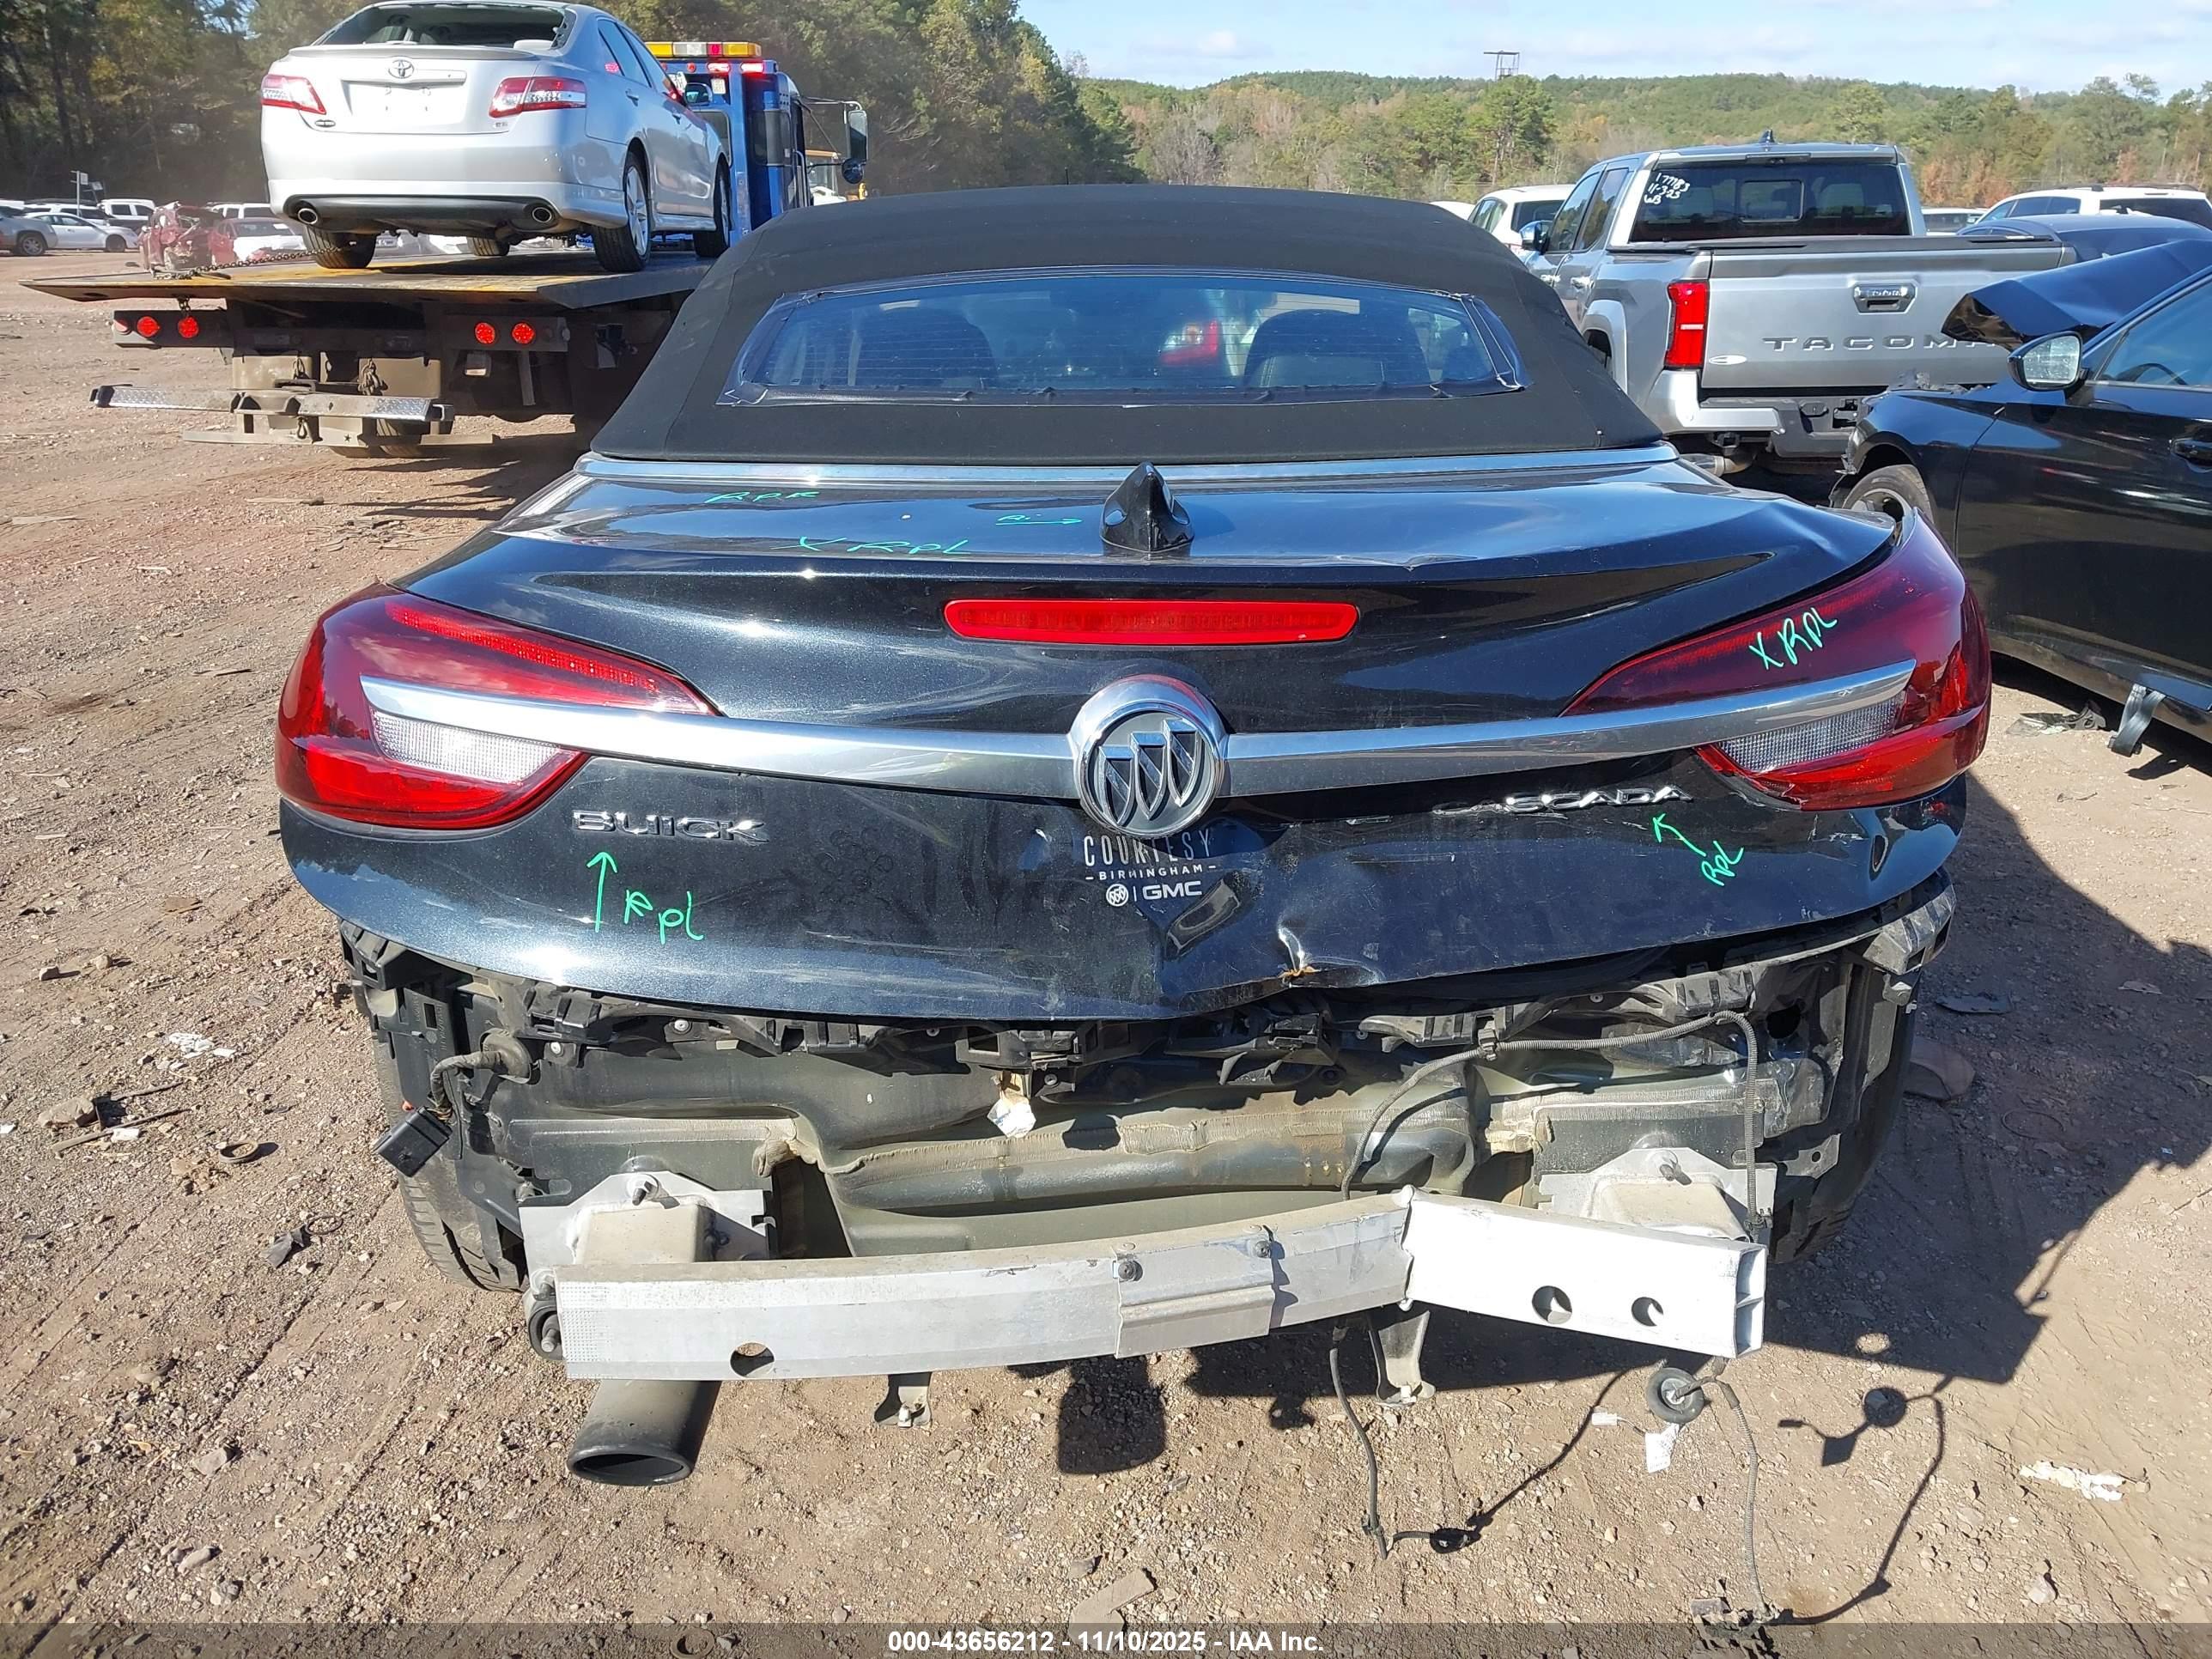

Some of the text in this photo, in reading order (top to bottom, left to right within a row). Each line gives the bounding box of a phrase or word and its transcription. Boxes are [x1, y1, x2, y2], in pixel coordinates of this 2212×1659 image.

[573, 810, 769, 845] BUICK
[1099, 865, 1203, 881] BIRMINGHAM
[1142, 881, 1203, 901] GMC
